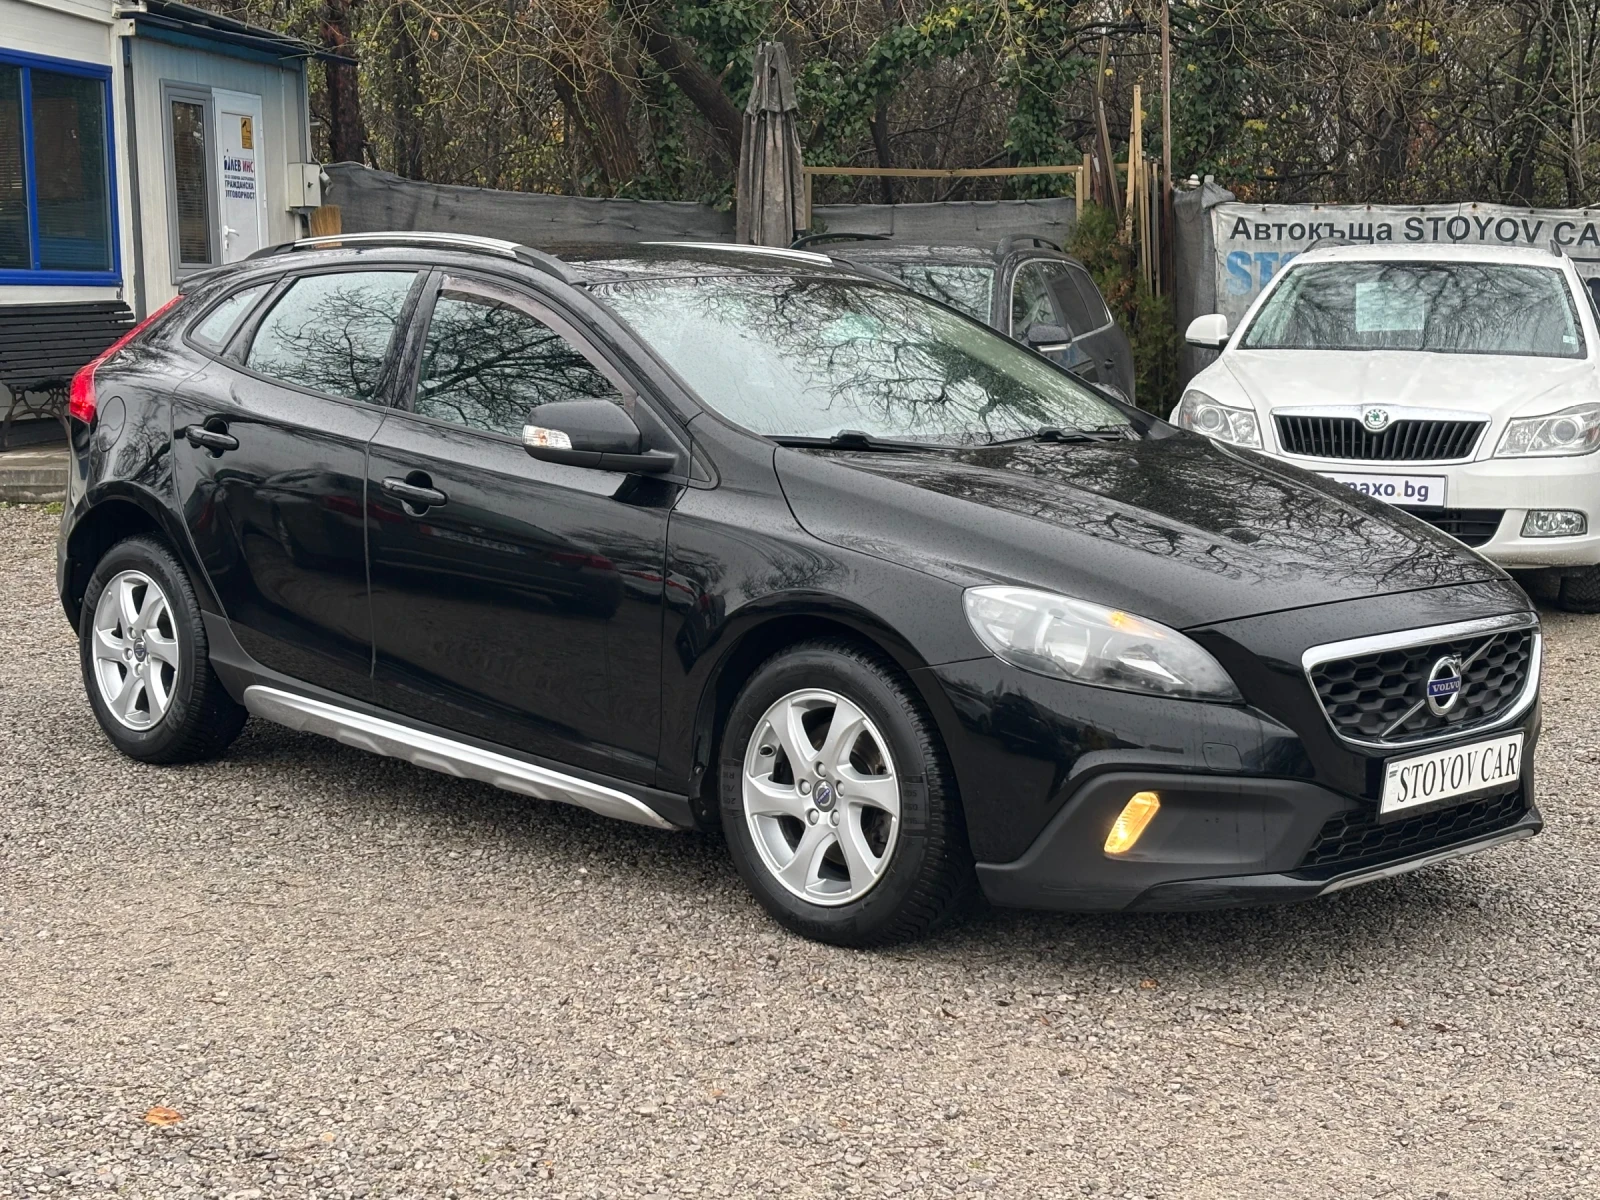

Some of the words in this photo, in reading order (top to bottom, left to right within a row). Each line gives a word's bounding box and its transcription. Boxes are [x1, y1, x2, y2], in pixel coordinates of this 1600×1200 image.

[1403, 215, 1544, 243] STOYOV
[1226, 250, 1303, 296] ST
[1432, 680, 1460, 693] VOLVO
[1397, 750, 1478, 803] STOYOV
[1481, 742, 1518, 783] CAR
